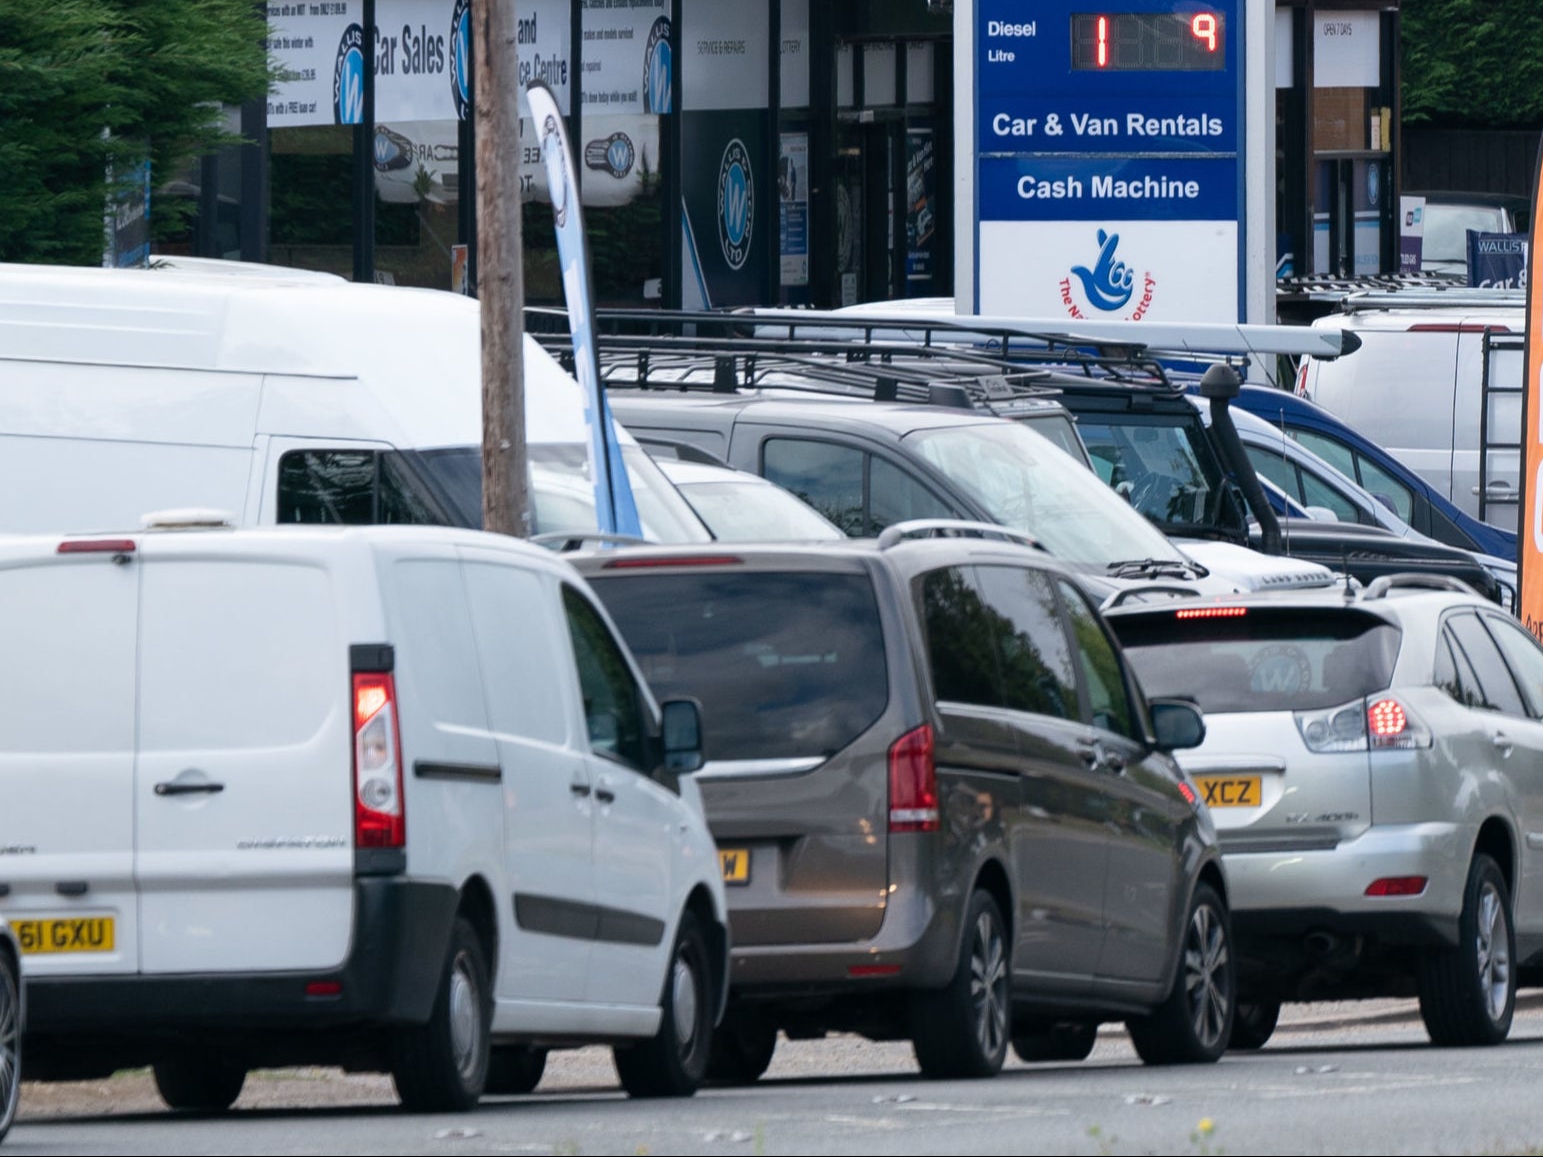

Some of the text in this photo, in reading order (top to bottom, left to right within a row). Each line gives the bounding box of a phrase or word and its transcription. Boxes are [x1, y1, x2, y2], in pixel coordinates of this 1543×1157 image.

[517, 11, 537, 45] and
[987, 20, 1037, 37] Diesel
[374, 24, 445, 76] Car Sales
[987, 49, 1016, 63] Litre
[534, 53, 567, 86] Centre
[992, 113, 1223, 136] Car & Van Rentals
[1017, 175, 1200, 198] Cash Machine
[1058, 277, 1156, 321] The ottery
[1204, 780, 1252, 805] XCZ
[50, 917, 105, 947] GXU
